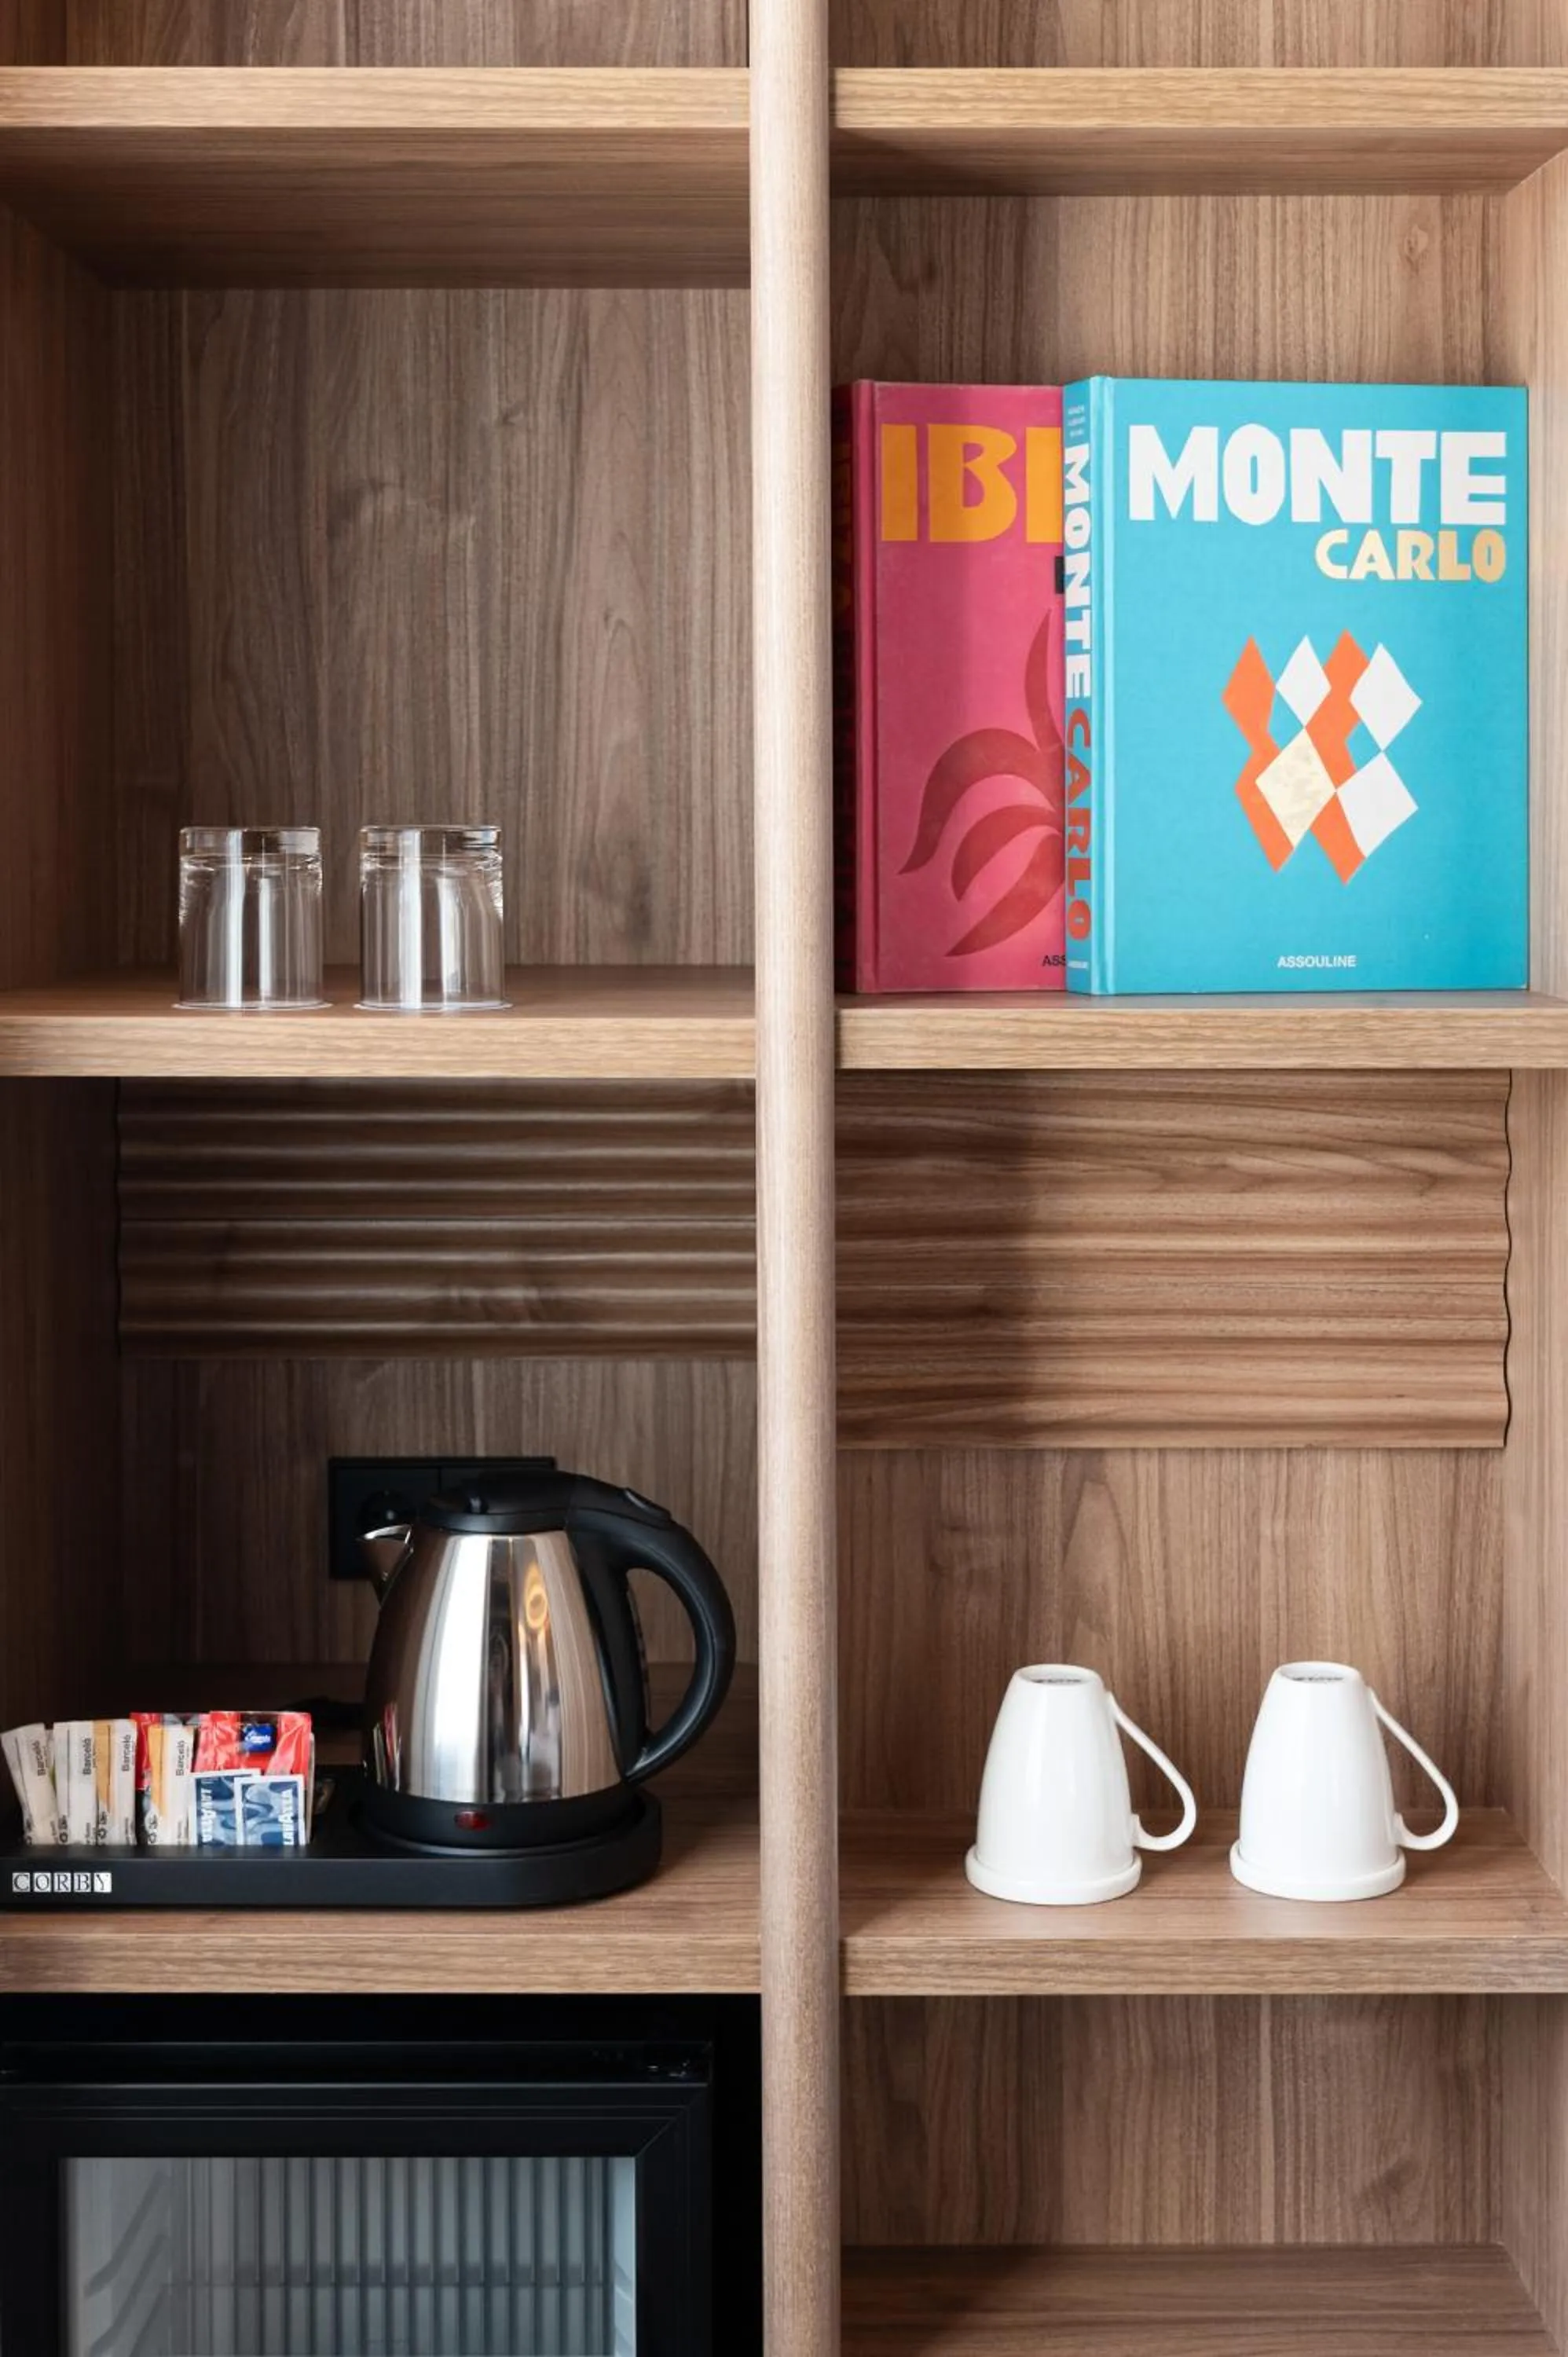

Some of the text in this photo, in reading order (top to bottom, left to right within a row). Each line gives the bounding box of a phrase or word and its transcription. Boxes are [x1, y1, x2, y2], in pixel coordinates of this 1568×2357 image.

[1129, 423, 1507, 526] MONTE
[1064, 443, 1091, 699] MONTE
[1315, 529, 1507, 583] CARLO
[1066, 708, 1092, 940] CARLO
[1277, 955, 1357, 969] ASSOULINE
[13, 1872, 112, 1893] CORBY
